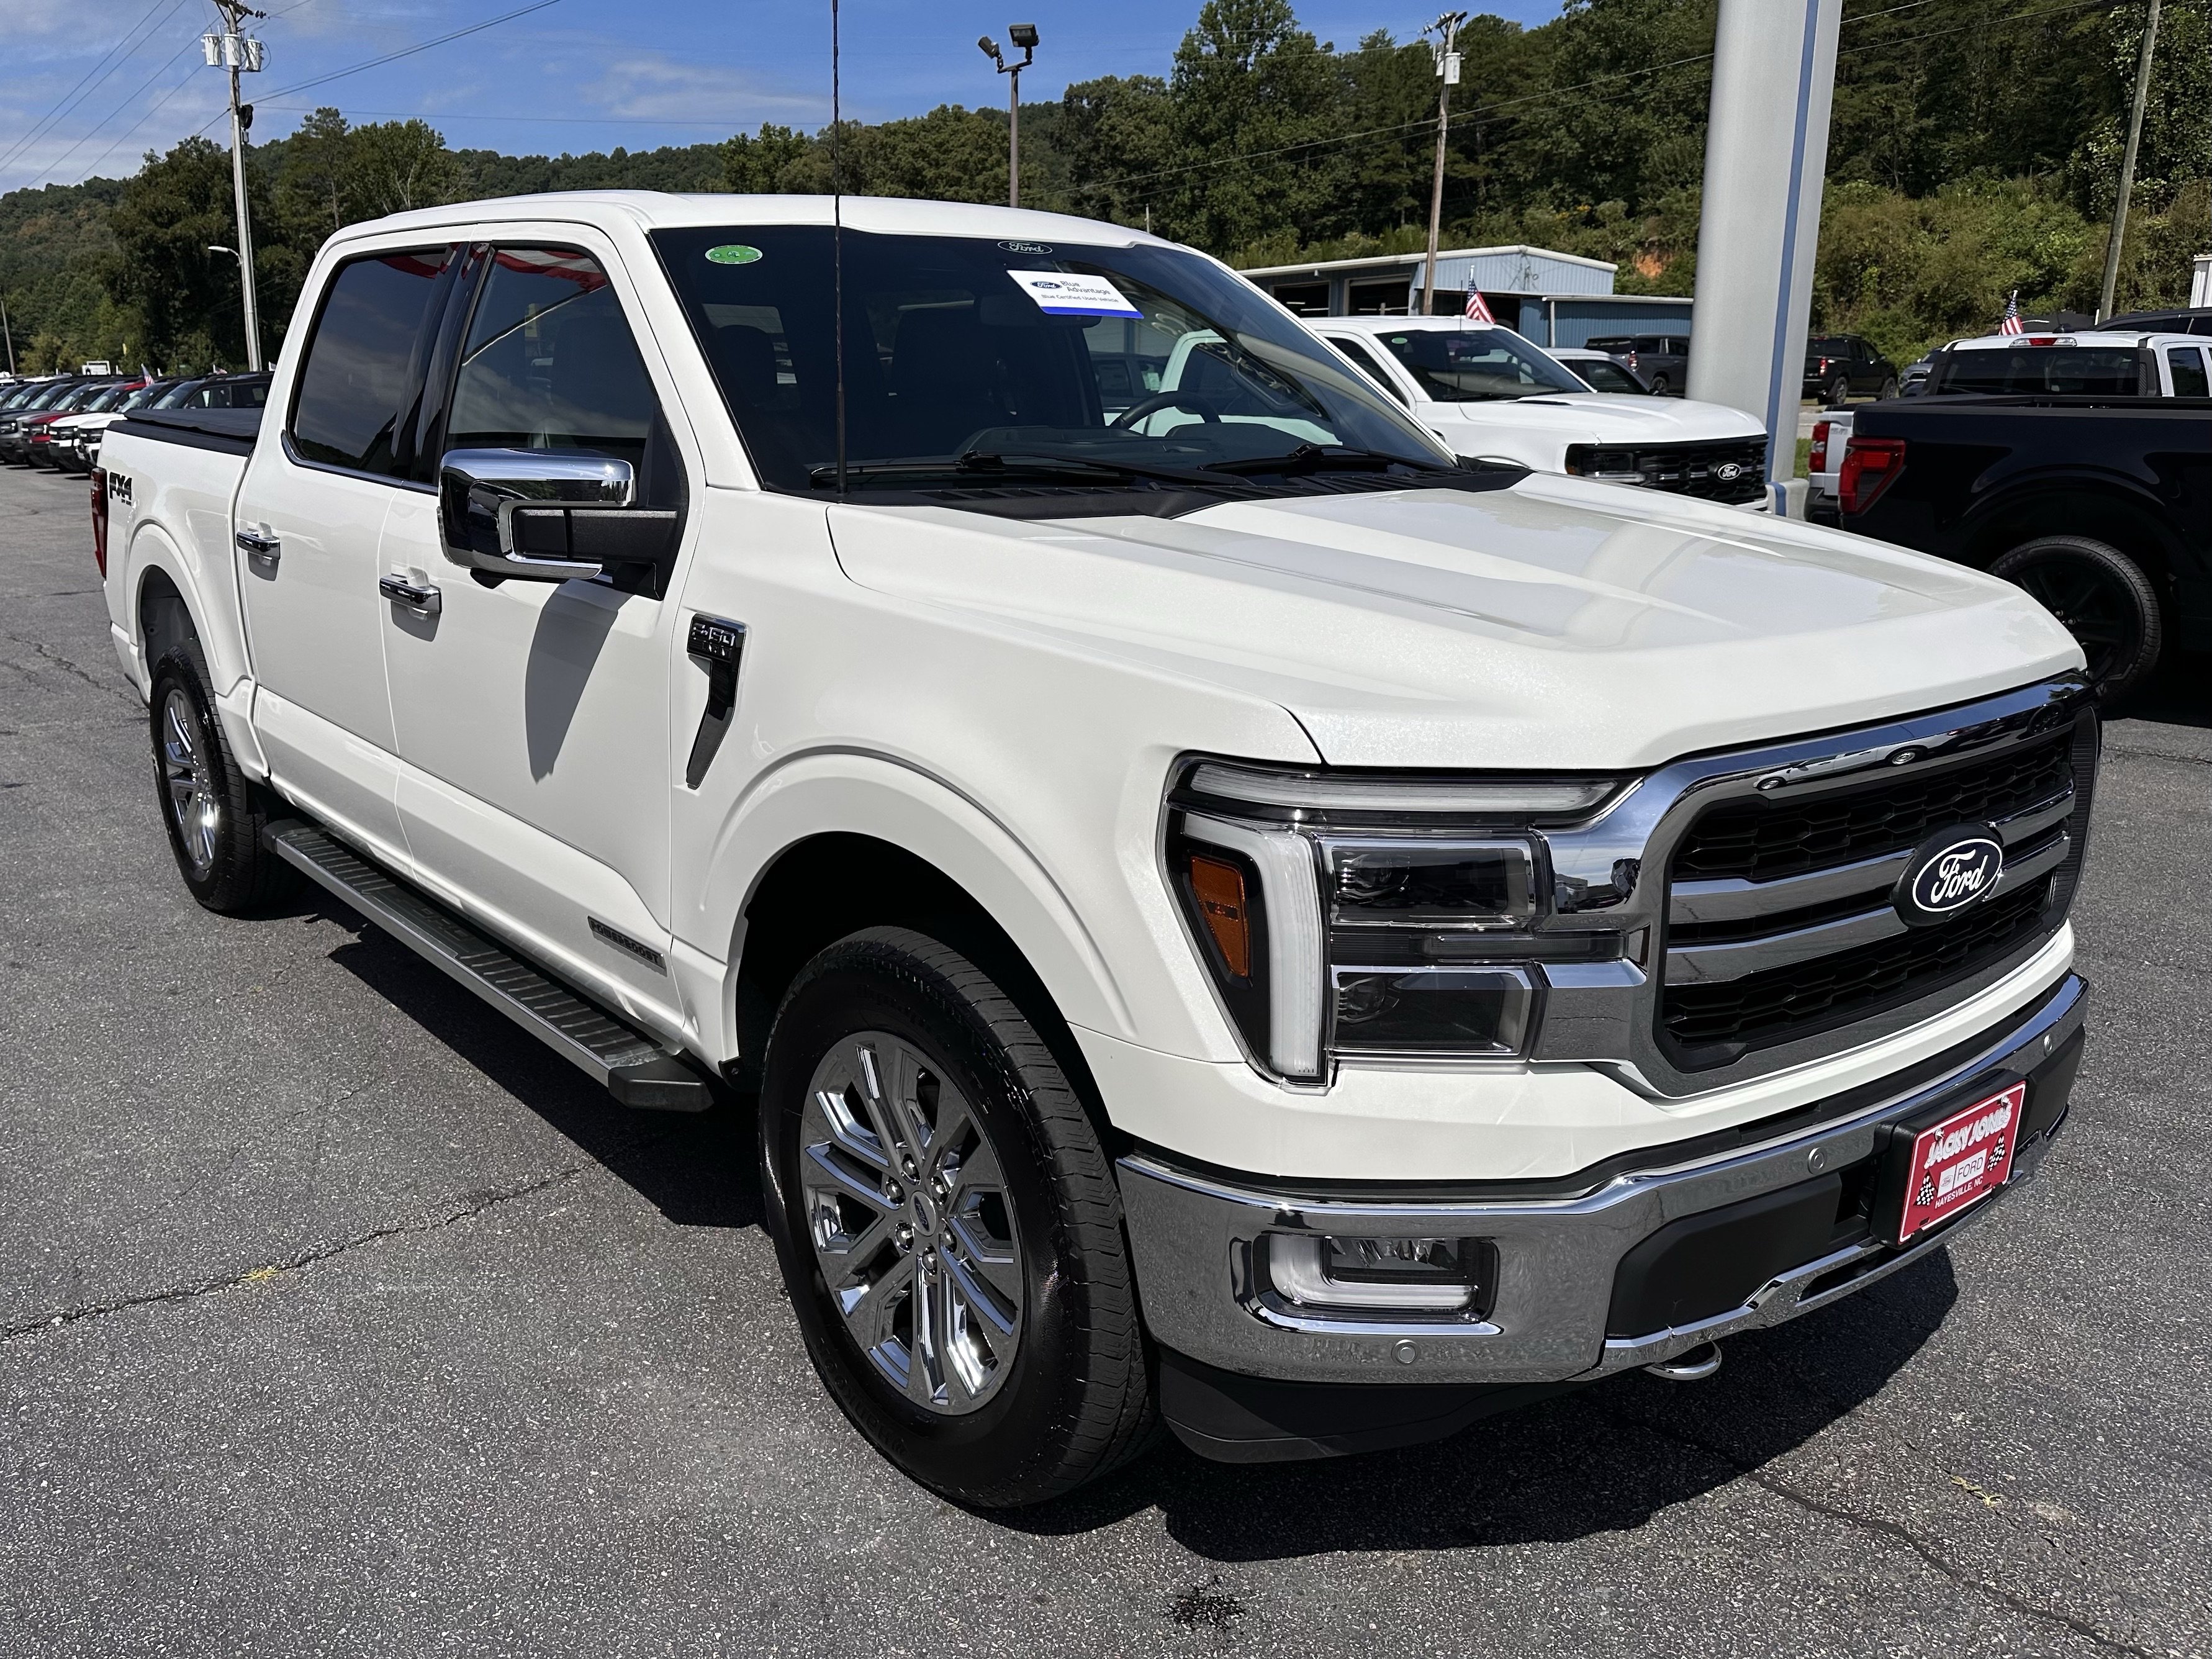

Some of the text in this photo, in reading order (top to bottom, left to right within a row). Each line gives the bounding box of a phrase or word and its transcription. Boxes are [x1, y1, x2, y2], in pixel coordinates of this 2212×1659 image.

[1008, 242, 1044, 253] Ford
[1067, 286, 1111, 295] Advantage
[1722, 466, 1738, 477] Ford
[109, 472, 132, 500] FX4
[1931, 849, 1988, 903] Ford
[590, 920, 658, 964] POWERBOOST
[1924, 1102, 2013, 1170] JACKY JONES
[1957, 1157, 1984, 1181] FORD
[1934, 1182, 1973, 1209] HAYESVILLE,
[1974, 1176, 1984, 1188] NC
